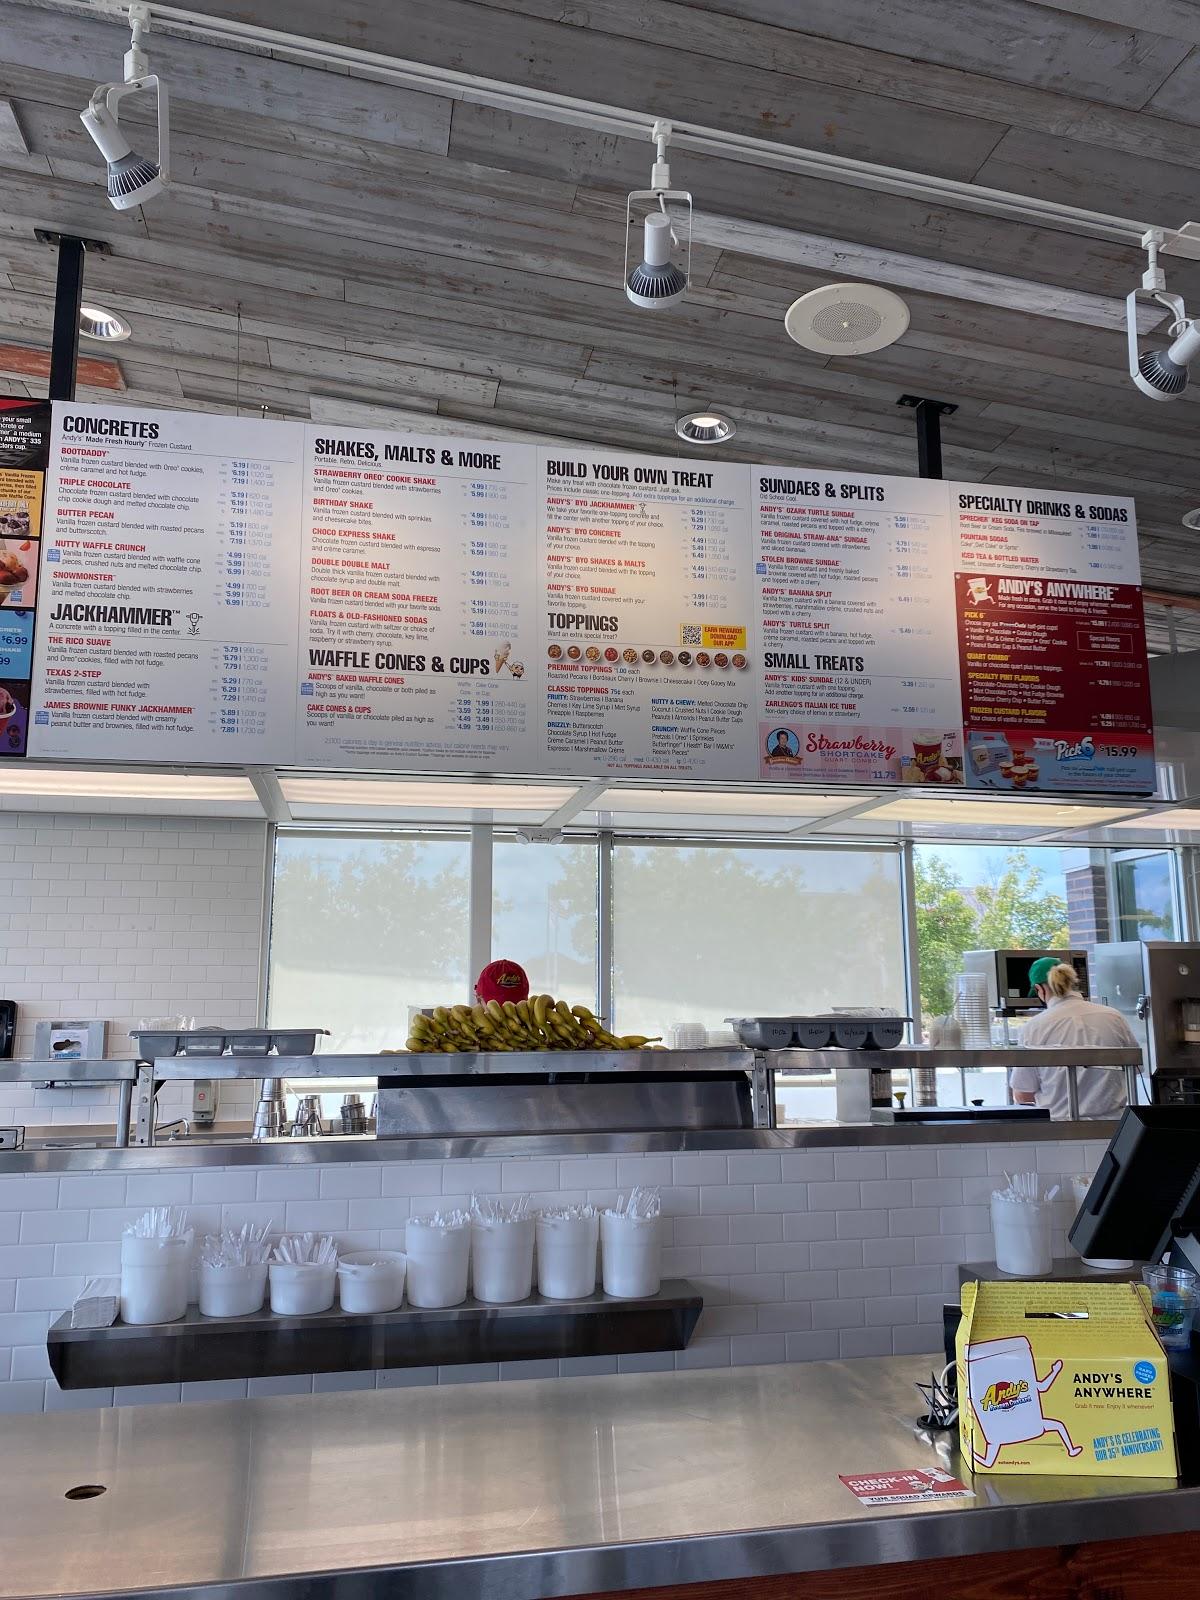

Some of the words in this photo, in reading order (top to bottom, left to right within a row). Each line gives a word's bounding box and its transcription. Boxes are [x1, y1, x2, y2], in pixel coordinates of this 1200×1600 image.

[63, 415, 158, 439] CONCRETES
[315, 438, 379, 459] SHAKES,
[385, 444, 435, 464] MALTS
[441, 449, 453, 465] &
[459, 451, 500, 470] MORE
[547, 460, 586, 478] BUILD
[592, 464, 628, 481] YOUR
[634, 467, 667, 484] OWN
[672, 470, 713, 488] TREAT
[60, 478, 85, 487] TRIPLE
[87, 480, 130, 490] CHOCOLATE
[760, 478, 819, 496] SUNDAES
[825, 483, 835, 498] &
[840, 484, 883, 501] SPLITS
[313, 498, 347, 508] BIRTHDAY
[349, 501, 372, 509] SHAKE
[958, 495, 1021, 513] SPECIALTY
[1026, 500, 1070, 517] DRINKS
[1075, 504, 1085, 519] &
[1089, 505, 1127, 522] SODAS
[57, 509, 86, 518] BUTTER
[89, 511, 113, 519] PECAN
[312, 528, 336, 537] CHOCO
[338, 530, 370, 539] EXPRESS
[372, 532, 395, 540] SHAKE
[773, 532, 801, 540] ORIGINAL
[844, 536, 867, 544] SUNDAE
[55, 540, 80, 549] NUTTY
[82, 541, 112, 550] WAFFLE
[114, 543, 145, 552] CRUNCH
[311, 558, 339, 567] DOUBLE
[341, 560, 368, 569] DOUBLE
[371, 562, 389, 570] MALT
[786, 557, 813, 565] BROWNIE
[998, 579, 1042, 596] ANDY'S
[311, 588, 329, 596] ROOT
[332, 589, 350, 597] BEER
[364, 591, 389, 600] CREAM
[391, 593, 410, 601] SODA
[412, 594, 437, 603] FREEZE
[310, 610, 336, 619] FLOATS
[346, 612, 402, 623] OLD-FASHIONED
[404, 616, 427, 624] SODAS
[548, 613, 617, 632] TOPPINGS
[2, 636, 28, 645] $6.99
[65, 637, 83, 645] RICO
[86, 638, 110, 646] SUAVE
[309, 649, 369, 668] WAFFLE
[375, 653, 425, 671] CONES
[431, 656, 444, 672] &
[450, 657, 489, 675] CUPS
[764, 652, 809, 670] SMALL
[814, 654, 863, 672] TREATS
[46, 669, 71, 677] TEXAS
[74, 670, 101, 678] 2-STEP
[547, 664, 578, 672] PREMIUM
[580, 665, 612, 673] TOPPINGS
[809, 676, 833, 684] SUNDAE
[577, 687, 608, 695] TOPPINGS
[43, 701, 70, 710] JAMES
[73, 702, 108, 711] BROWNIE
[110, 704, 136, 712] FUNKY
[307, 704, 323, 712] CAKE
[325, 705, 346, 713] CONES
[354, 706, 371, 714] CUPS
[806, 732, 896, 760] Strawberry
[1054, 740, 1082, 760] Pick
[1081, 736, 1095, 757] 6
[1100, 744, 1137, 757] $15.99
[820, 751, 884, 759] SHORTCAKE
[1073, 1374, 1122, 1384] ANDY'S
[980, 1380, 1028, 1411] Andy's
[1093, 1435, 1115, 1449] ANDY'S
[1116, 1434, 1121, 1446] IS
[1122, 1428, 1160, 1444] CELEBRATING
[1095, 1450, 1108, 1461] OUR
[1122, 1439, 1164, 1456] ANNIVERSARY!
[848, 1475, 920, 1486] CHECK-IN
[852, 1483, 893, 1492] NOW!
